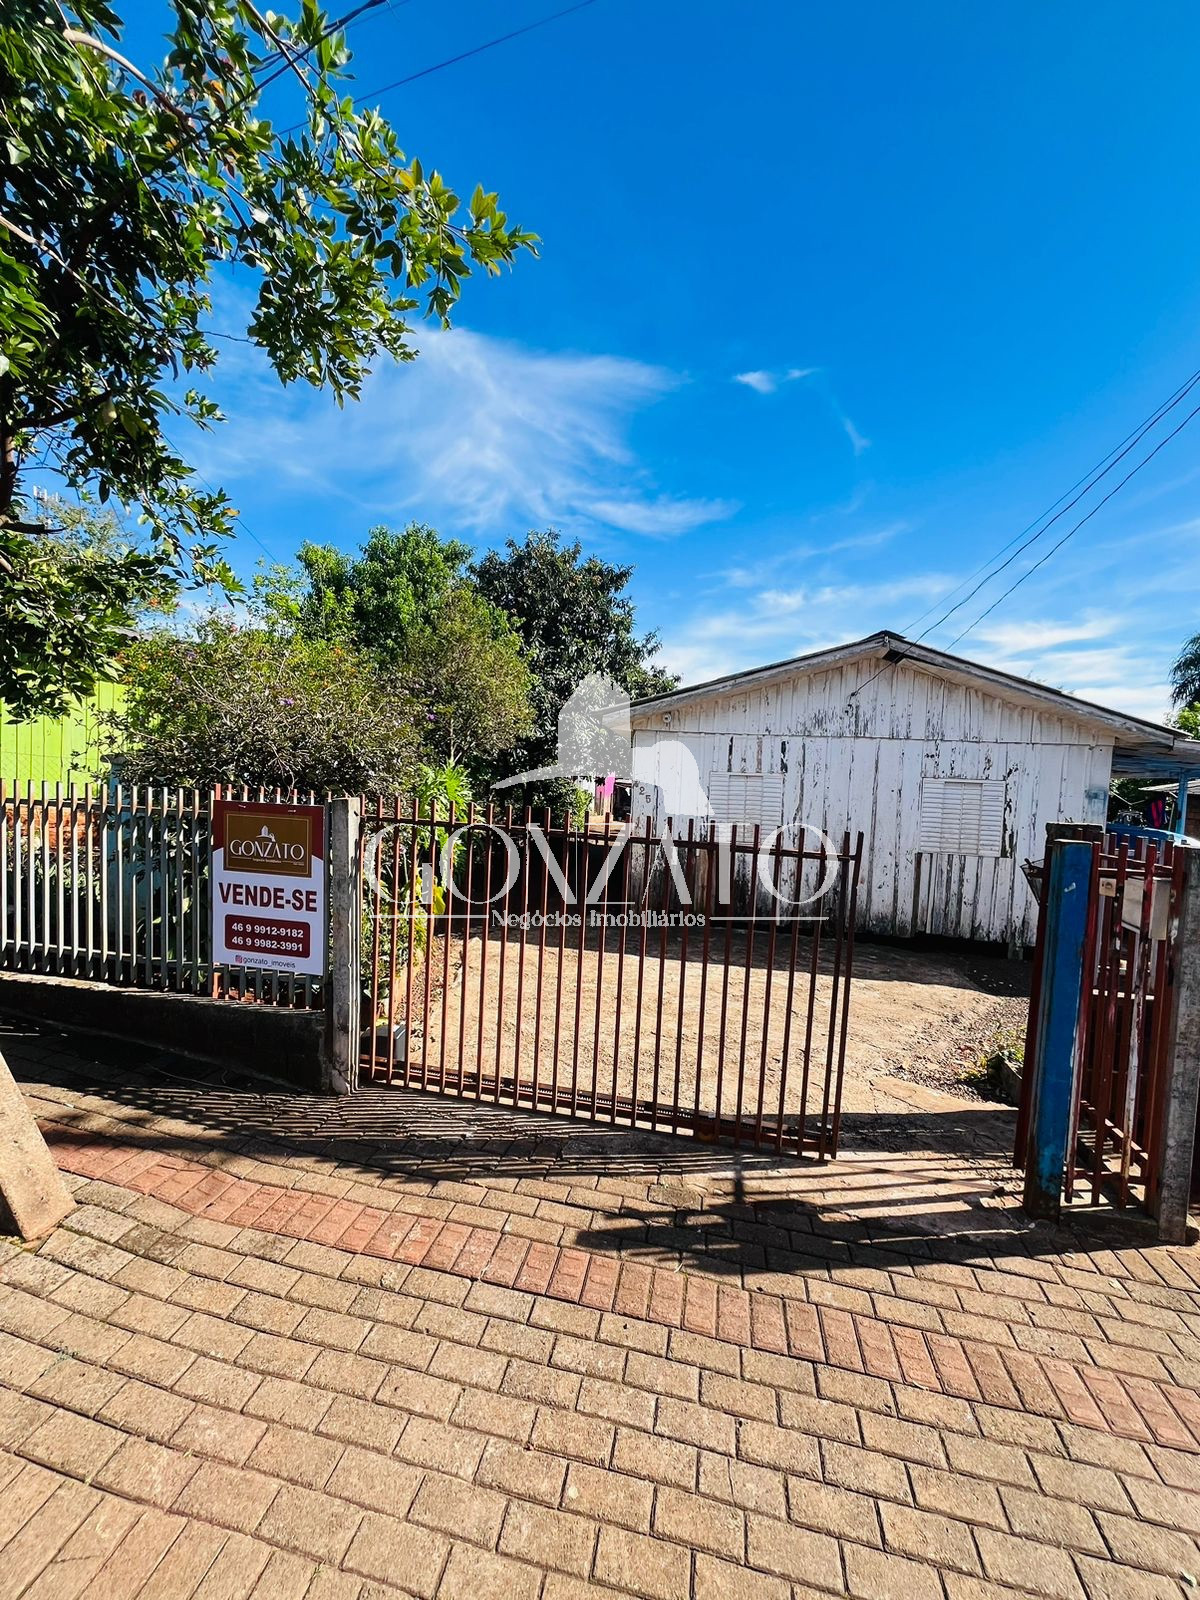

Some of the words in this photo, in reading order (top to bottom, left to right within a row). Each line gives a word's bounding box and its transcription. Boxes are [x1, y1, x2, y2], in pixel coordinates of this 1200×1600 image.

[230, 839, 305, 861] GONZATO
[218, 882, 318, 913] VENDE-SE
[231, 922, 244, 932] 46
[245, 923, 252, 933] 9
[254, 925, 304, 938] 9912-9182
[231, 936, 244, 945] 46
[245, 937, 252, 946] 9
[254, 938, 303, 952] 9982-3991
[243, 956, 296, 969] gonzato_imoveis
